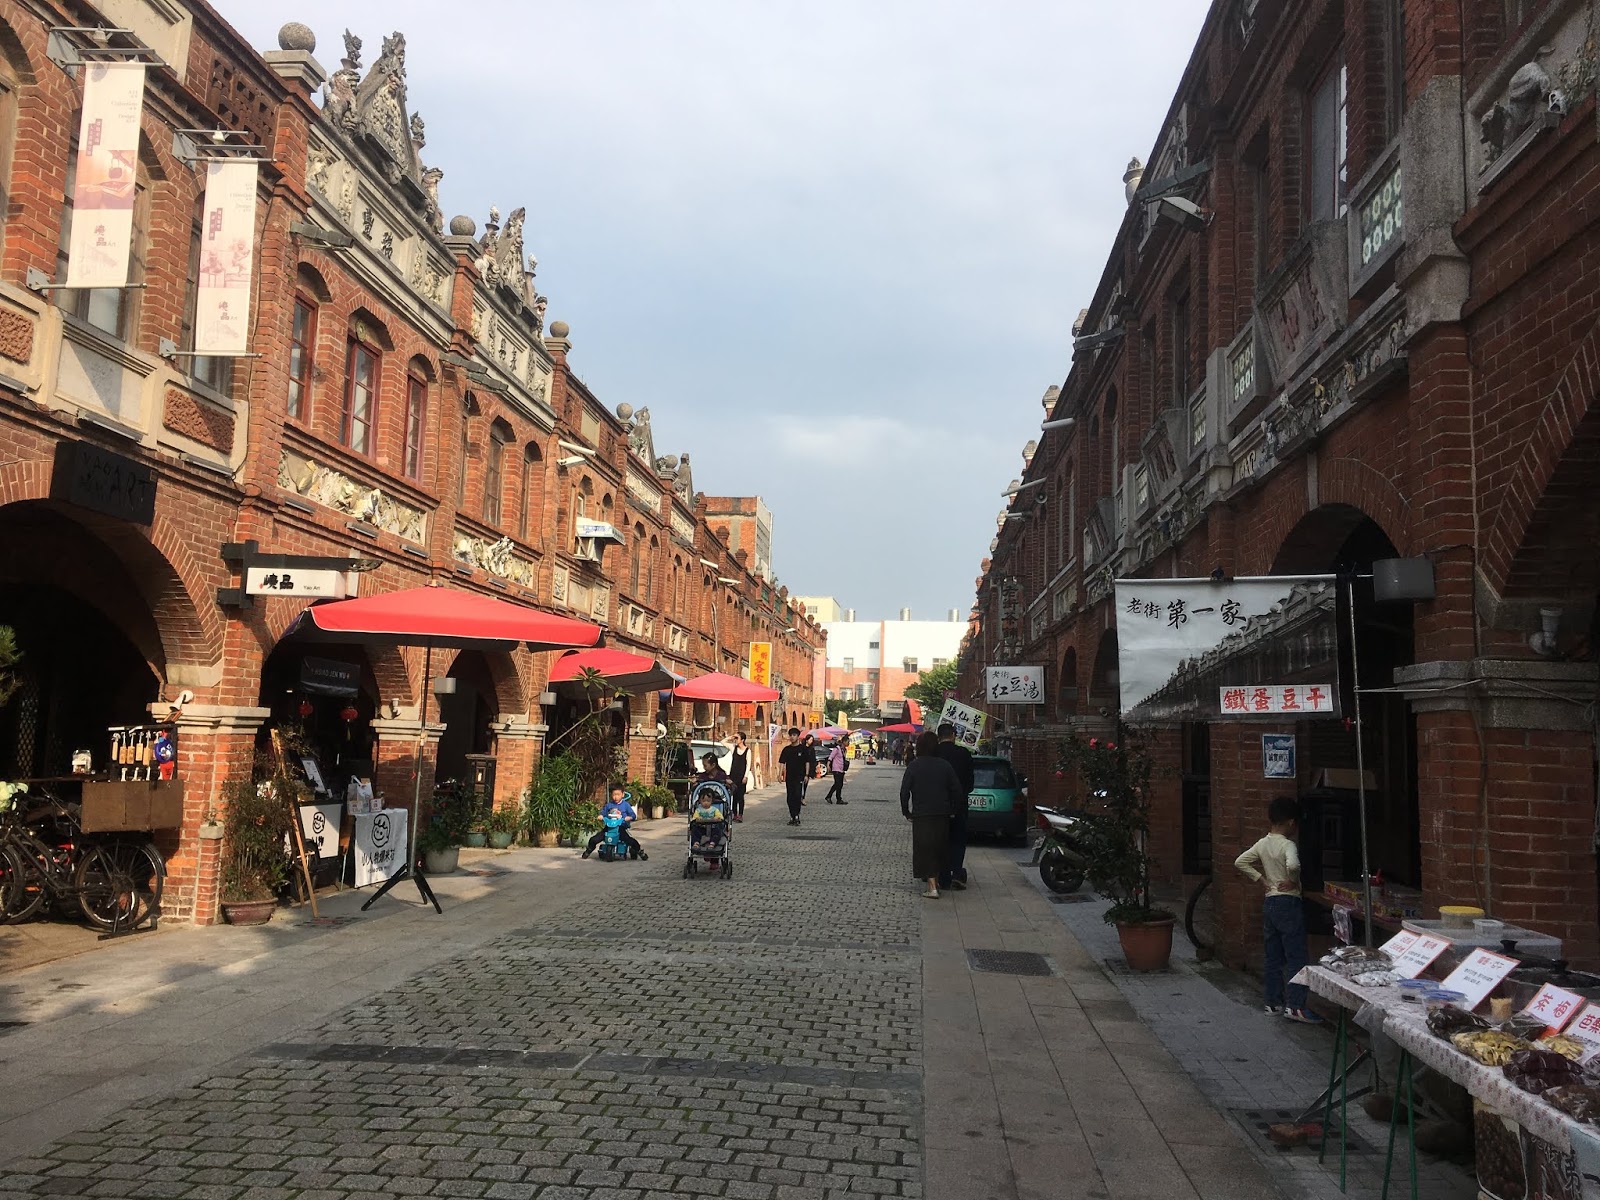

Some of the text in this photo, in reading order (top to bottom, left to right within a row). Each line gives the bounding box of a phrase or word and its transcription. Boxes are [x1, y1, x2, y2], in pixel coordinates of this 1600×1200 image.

[1126, 598, 1247, 630] 老街第一家
[1223, 687, 1325, 712] 鐵蛋豆干
